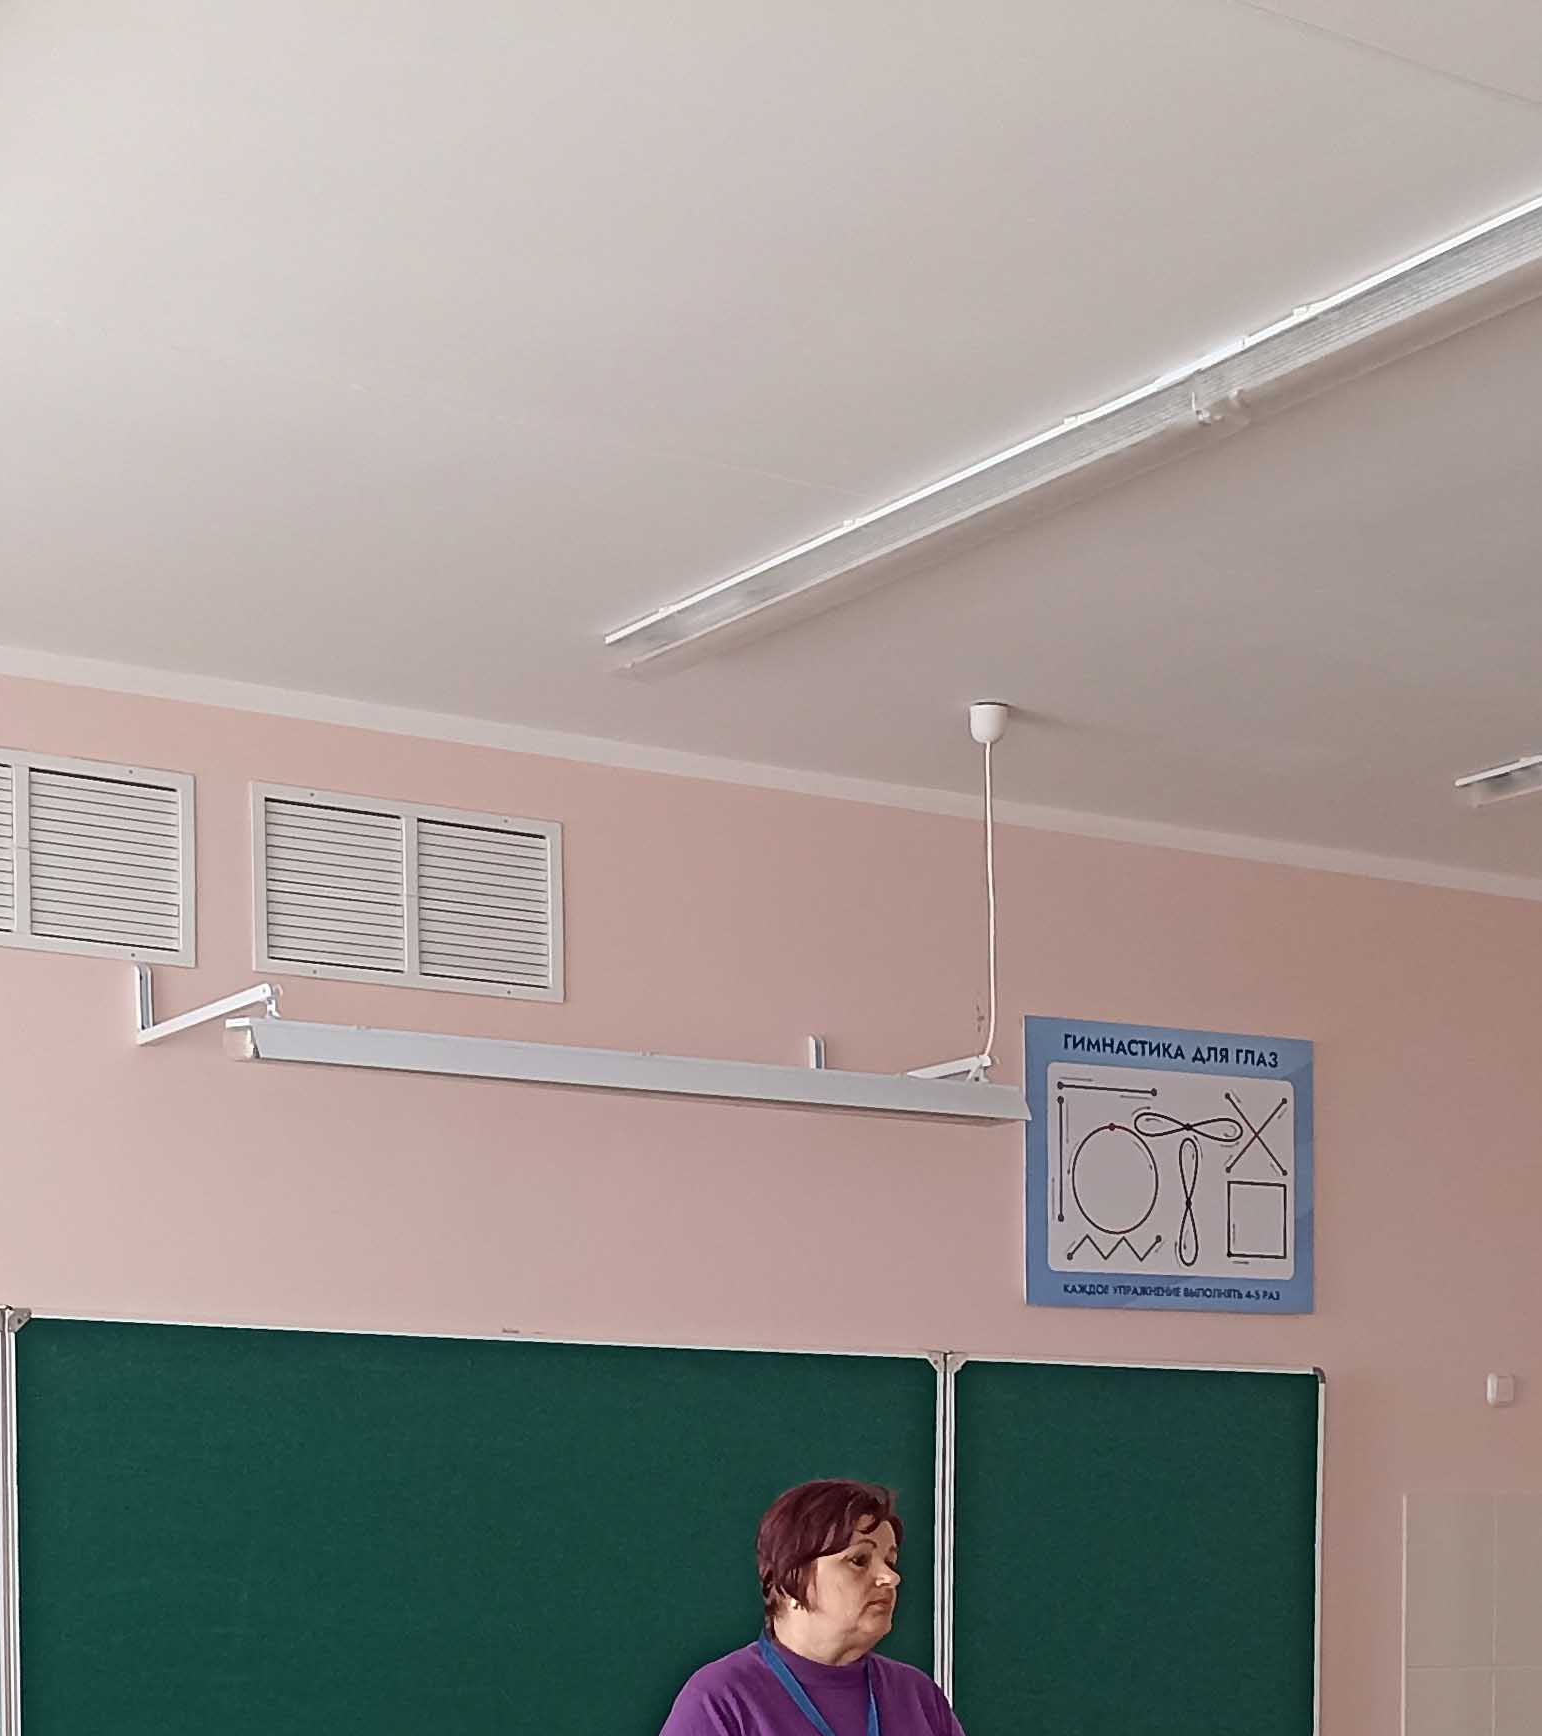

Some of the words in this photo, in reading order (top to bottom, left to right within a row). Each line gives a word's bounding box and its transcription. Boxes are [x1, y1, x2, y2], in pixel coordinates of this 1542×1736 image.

[1063, 1033, 1185, 1060] ГИМНАСТИКА
[1191, 1046, 1229, 1064] ДЛЯ
[1235, 1049, 1278, 1068] ГЛАЗ
[1063, 1283, 1109, 1296] КАЖДОЕ
